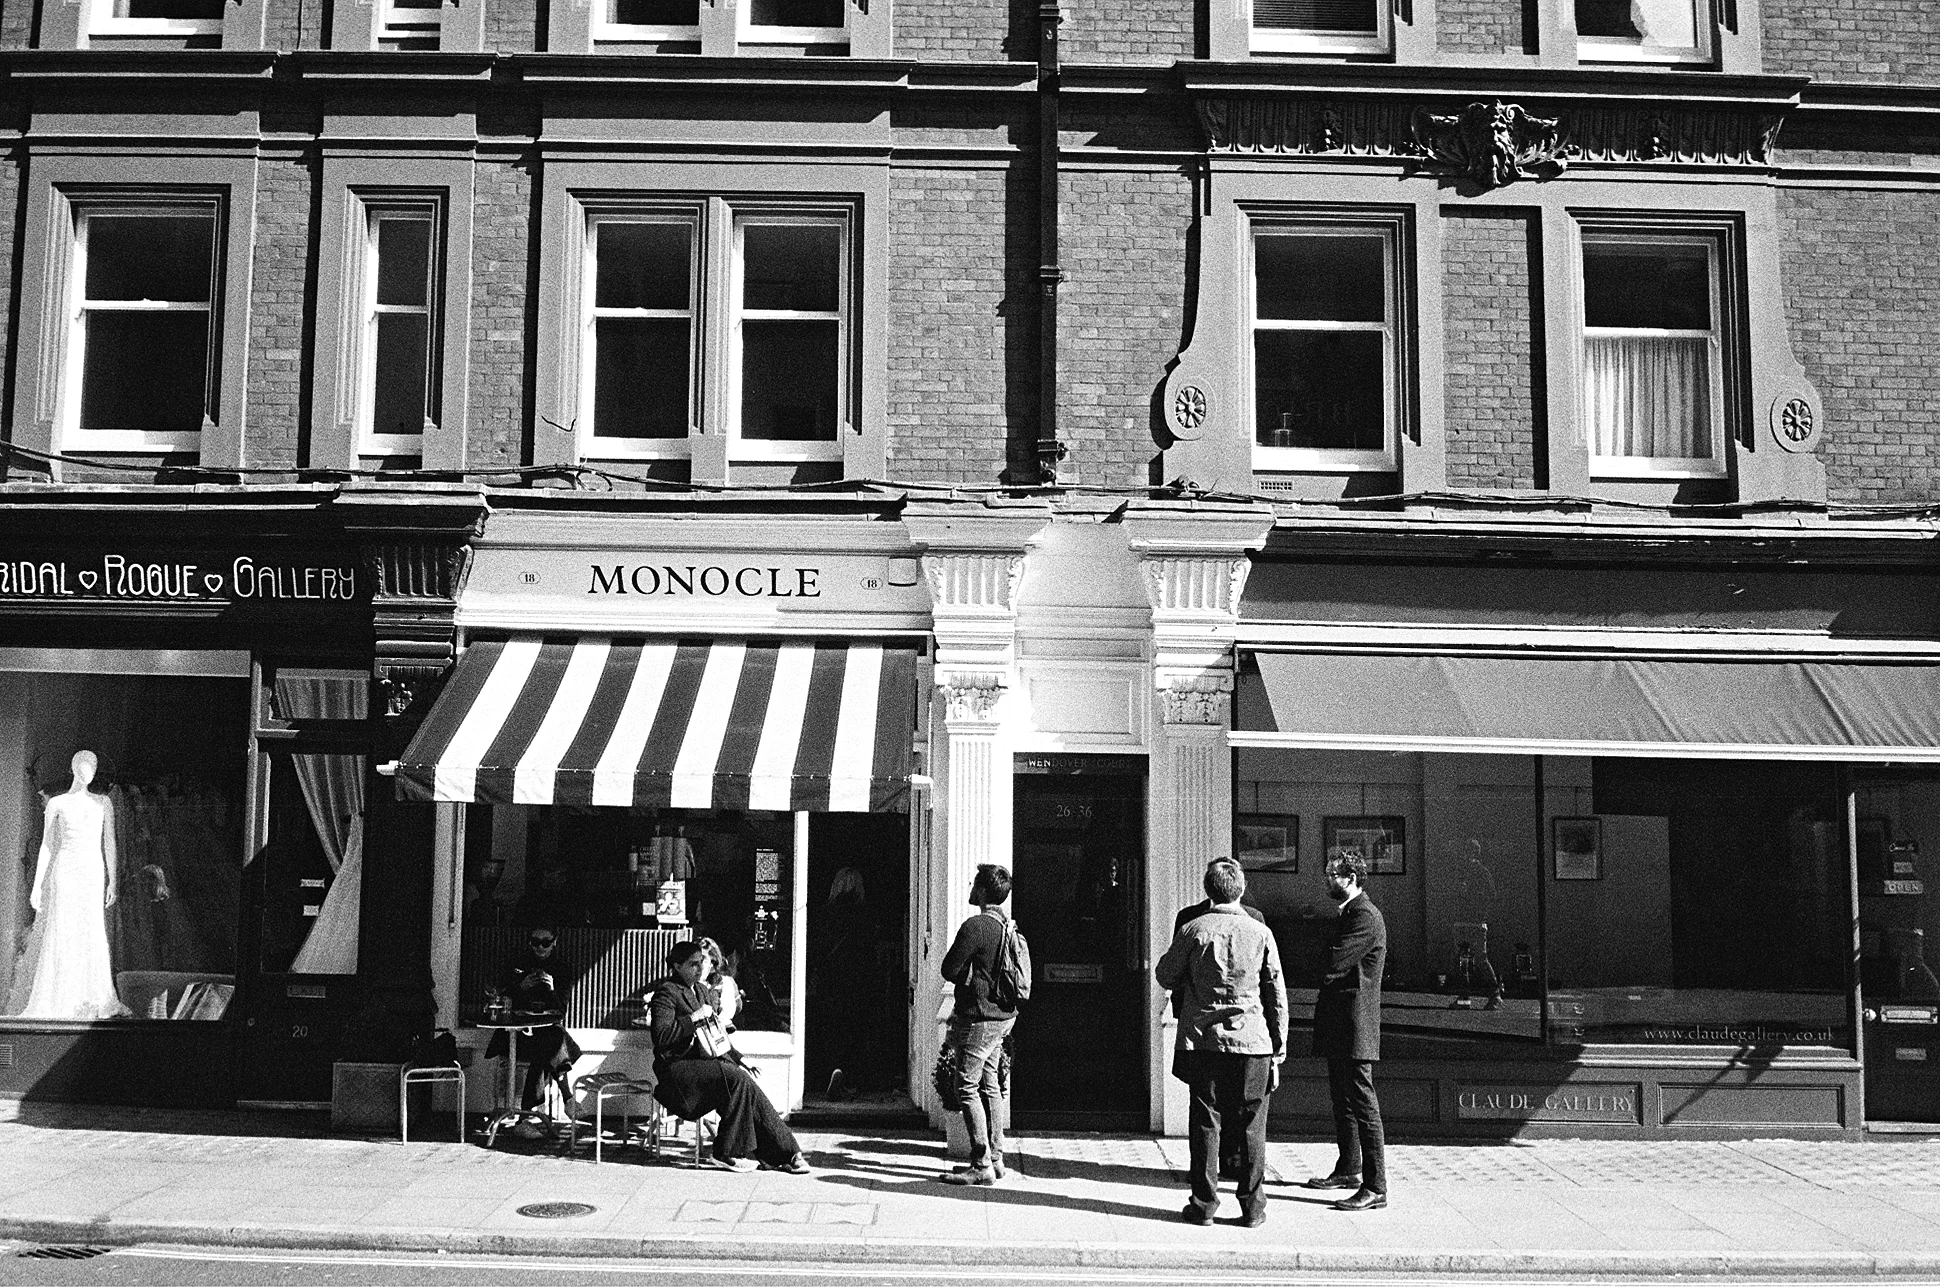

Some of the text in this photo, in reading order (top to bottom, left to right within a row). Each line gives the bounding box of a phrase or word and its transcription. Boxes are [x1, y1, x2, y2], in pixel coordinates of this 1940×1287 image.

[104, 555, 199, 596] ROGUE
[233, 556, 354, 600] GALLERY
[525, 573, 535, 582] 18
[588, 565, 821, 597] MONOCLE
[867, 580, 878, 588] 18
[292, 1024, 308, 1038] 20
[1644, 1025, 1834, 1042] www.claudegallery.co.uk
[1459, 1093, 1633, 1111] CLAUDE GALLERY
